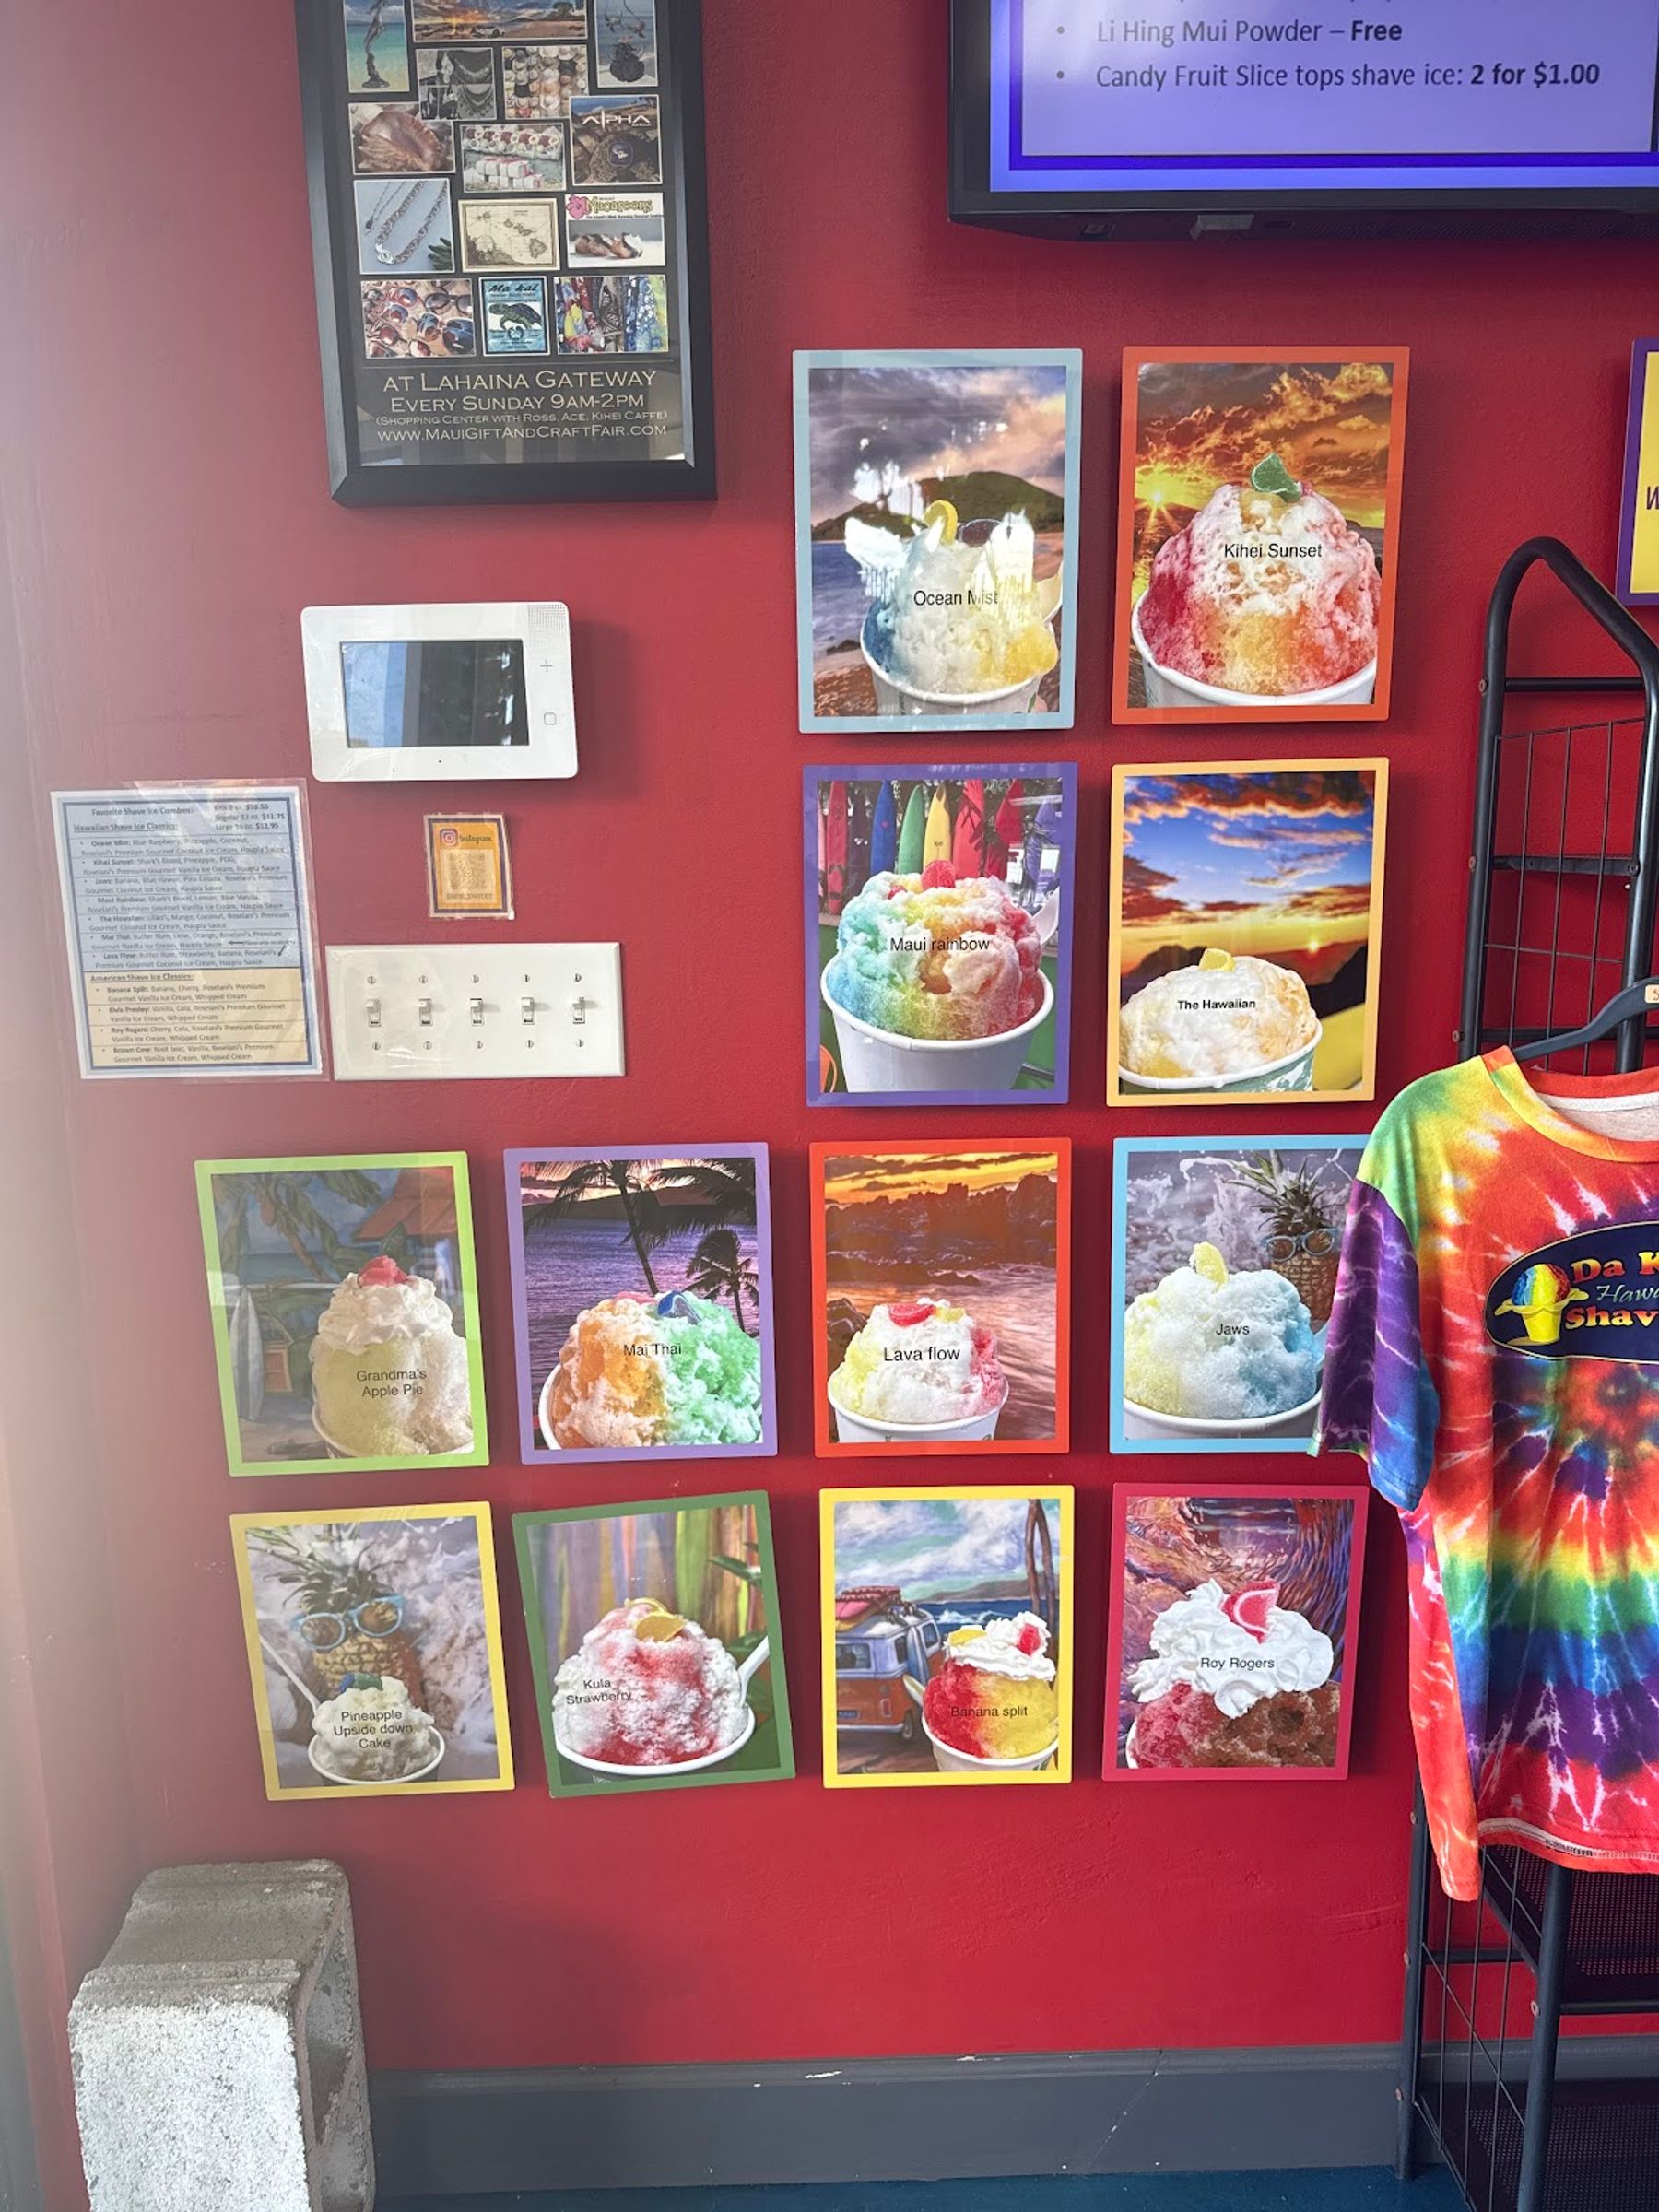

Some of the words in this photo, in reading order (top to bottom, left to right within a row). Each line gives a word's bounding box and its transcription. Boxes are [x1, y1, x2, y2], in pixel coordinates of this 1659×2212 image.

[1097, 20, 1114, 41] Li
[1124, 19, 1175, 47] Hing
[1182, 19, 1227, 41] Mui
[1235, 19, 1323, 41] Powder
[1351, 19, 1403, 41] Free
[1096, 65, 1166, 91] Candy
[1175, 65, 1228, 87] Fruit
[1235, 64, 1288, 87] Slice
[1295, 66, 1345, 90] tops
[1351, 63, 1415, 86] shave
[1424, 63, 1463, 85] ice:
[1470, 64, 1485, 85] 2
[1491, 63, 1525, 85] for
[1533, 61, 1600, 88] $1.00
[383, 376, 414, 393] AT
[420, 373, 530, 392] LAHAINA
[535, 370, 656, 389] GATEWAY
[391, 397, 457, 413] EVERY
[462, 395, 545, 412] SUNDAY
[551, 393, 644, 409] 9AM-2PM
[441, 414, 489, 425] CENTER
[491, 414, 521, 424] WITH
[592, 411, 622, 421] KIHEI
[1224, 543, 1263, 559] Kihei
[1267, 543, 1323, 559] Sunset
[913, 590, 962, 606] Ocean
[890, 937, 927, 951] Maui
[931, 937, 990, 951] rainbow
[1178, 1000, 1199, 1010] The
[1571, 1258, 1626, 1284] Da
[1216, 1323, 1250, 1335] Jaws
[623, 1345, 649, 1357] Mai
[653, 1342, 682, 1356] Thai
[883, 1347, 923, 1361] Lava
[927, 1346, 960, 1361] flow
[356, 1368, 427, 1382] Grandma's
[361, 1384, 399, 1399] Apple
[403, 1383, 423, 1395] Pie
[1200, 1657, 1225, 1671] Roy
[1230, 1657, 1275, 1670] Rogers
[582, 1678, 611, 1690] Kula
[566, 1690, 632, 1705] Strawberry
[341, 1709, 403, 1722] Pineapple
[950, 1706, 999, 1717] Banana
[1002, 1705, 1029, 1719] split
[333, 1724, 377, 1737] Upside
[380, 1724, 414, 1734] down
[359, 1737, 391, 1749] Cake
